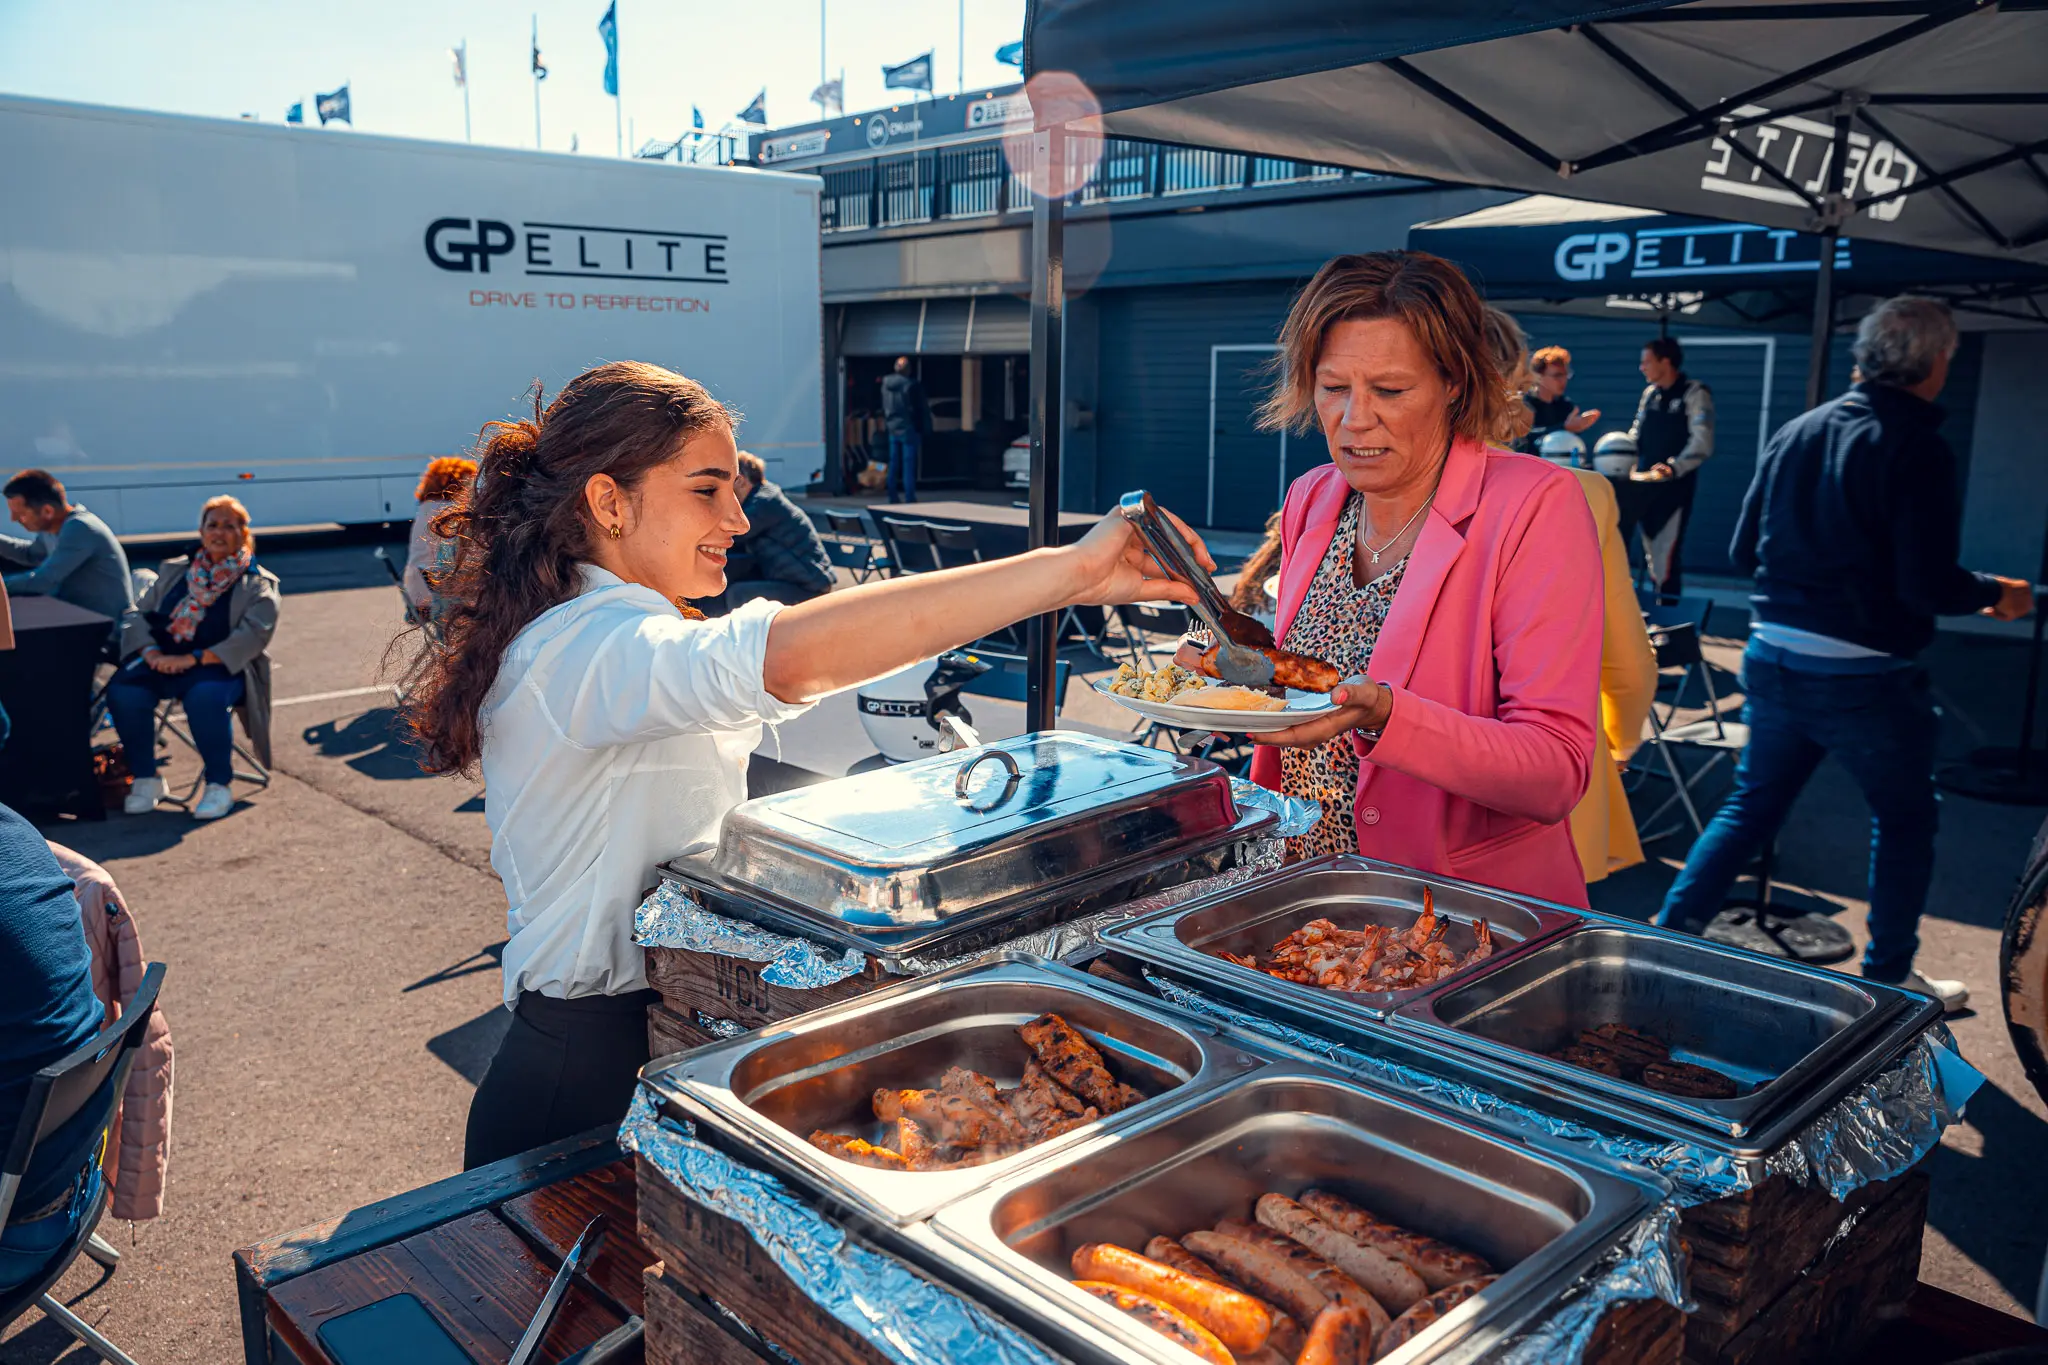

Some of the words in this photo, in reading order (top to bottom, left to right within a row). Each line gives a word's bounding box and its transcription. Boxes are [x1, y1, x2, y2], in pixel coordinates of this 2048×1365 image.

[525, 232, 728, 274] ELITE
[469, 290, 537, 308] DRIVE
[544, 293, 575, 309] TO
[582, 294, 711, 313] PERFECTION
